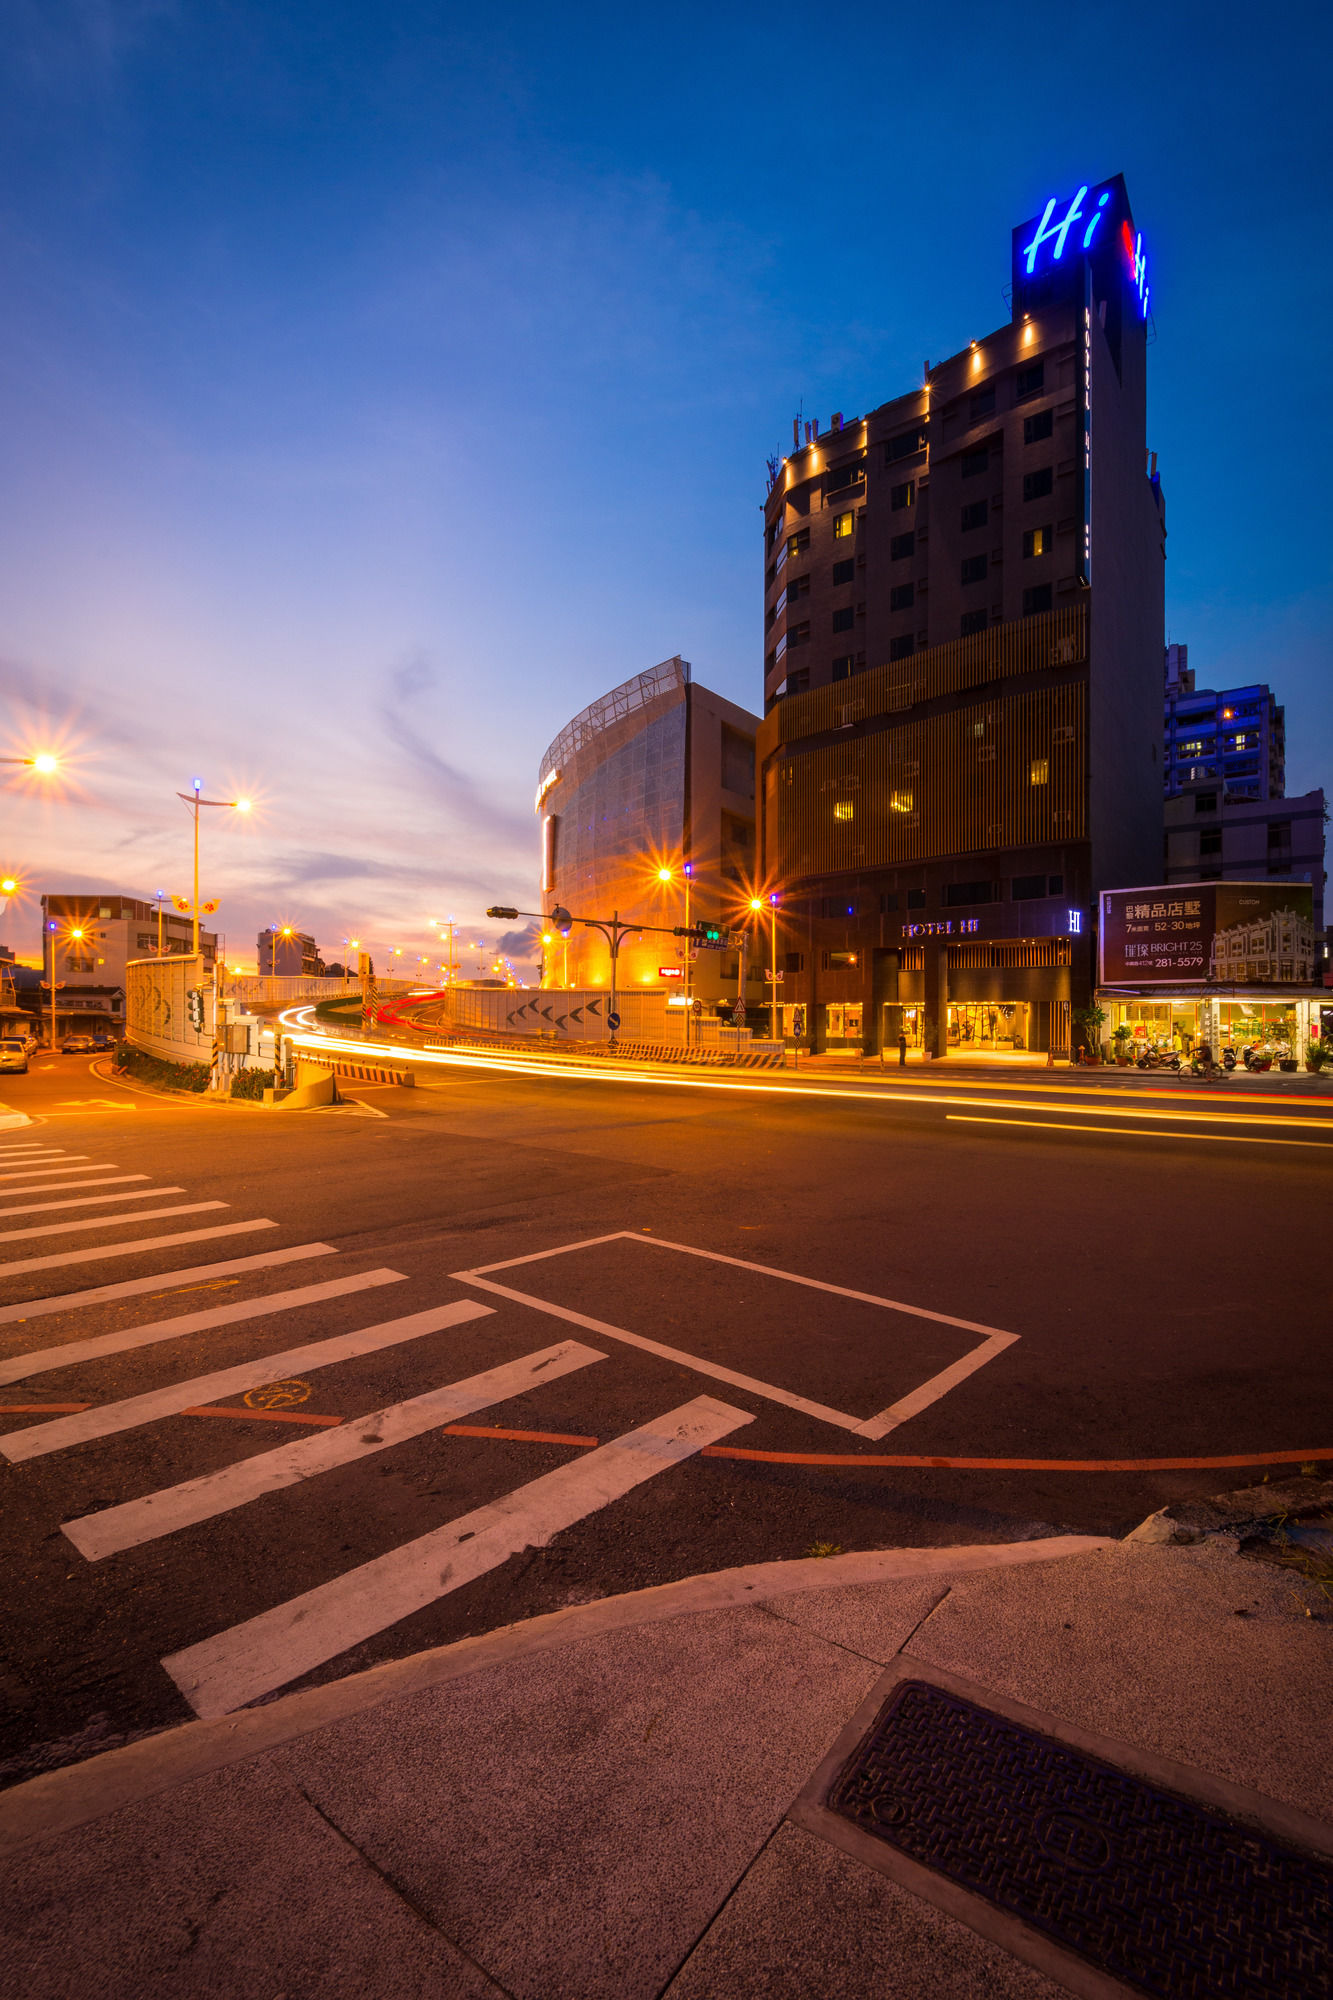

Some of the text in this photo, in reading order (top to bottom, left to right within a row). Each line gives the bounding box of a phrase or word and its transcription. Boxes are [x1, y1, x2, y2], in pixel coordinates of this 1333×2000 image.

[1023, 185, 1109, 274] Hi
[901, 919, 979, 938] HOTEL HI
[1068, 910, 1081, 933] HI
[1150, 942, 1189, 953] BRIGHT
[1155, 956, 1204, 968] 281-5579
